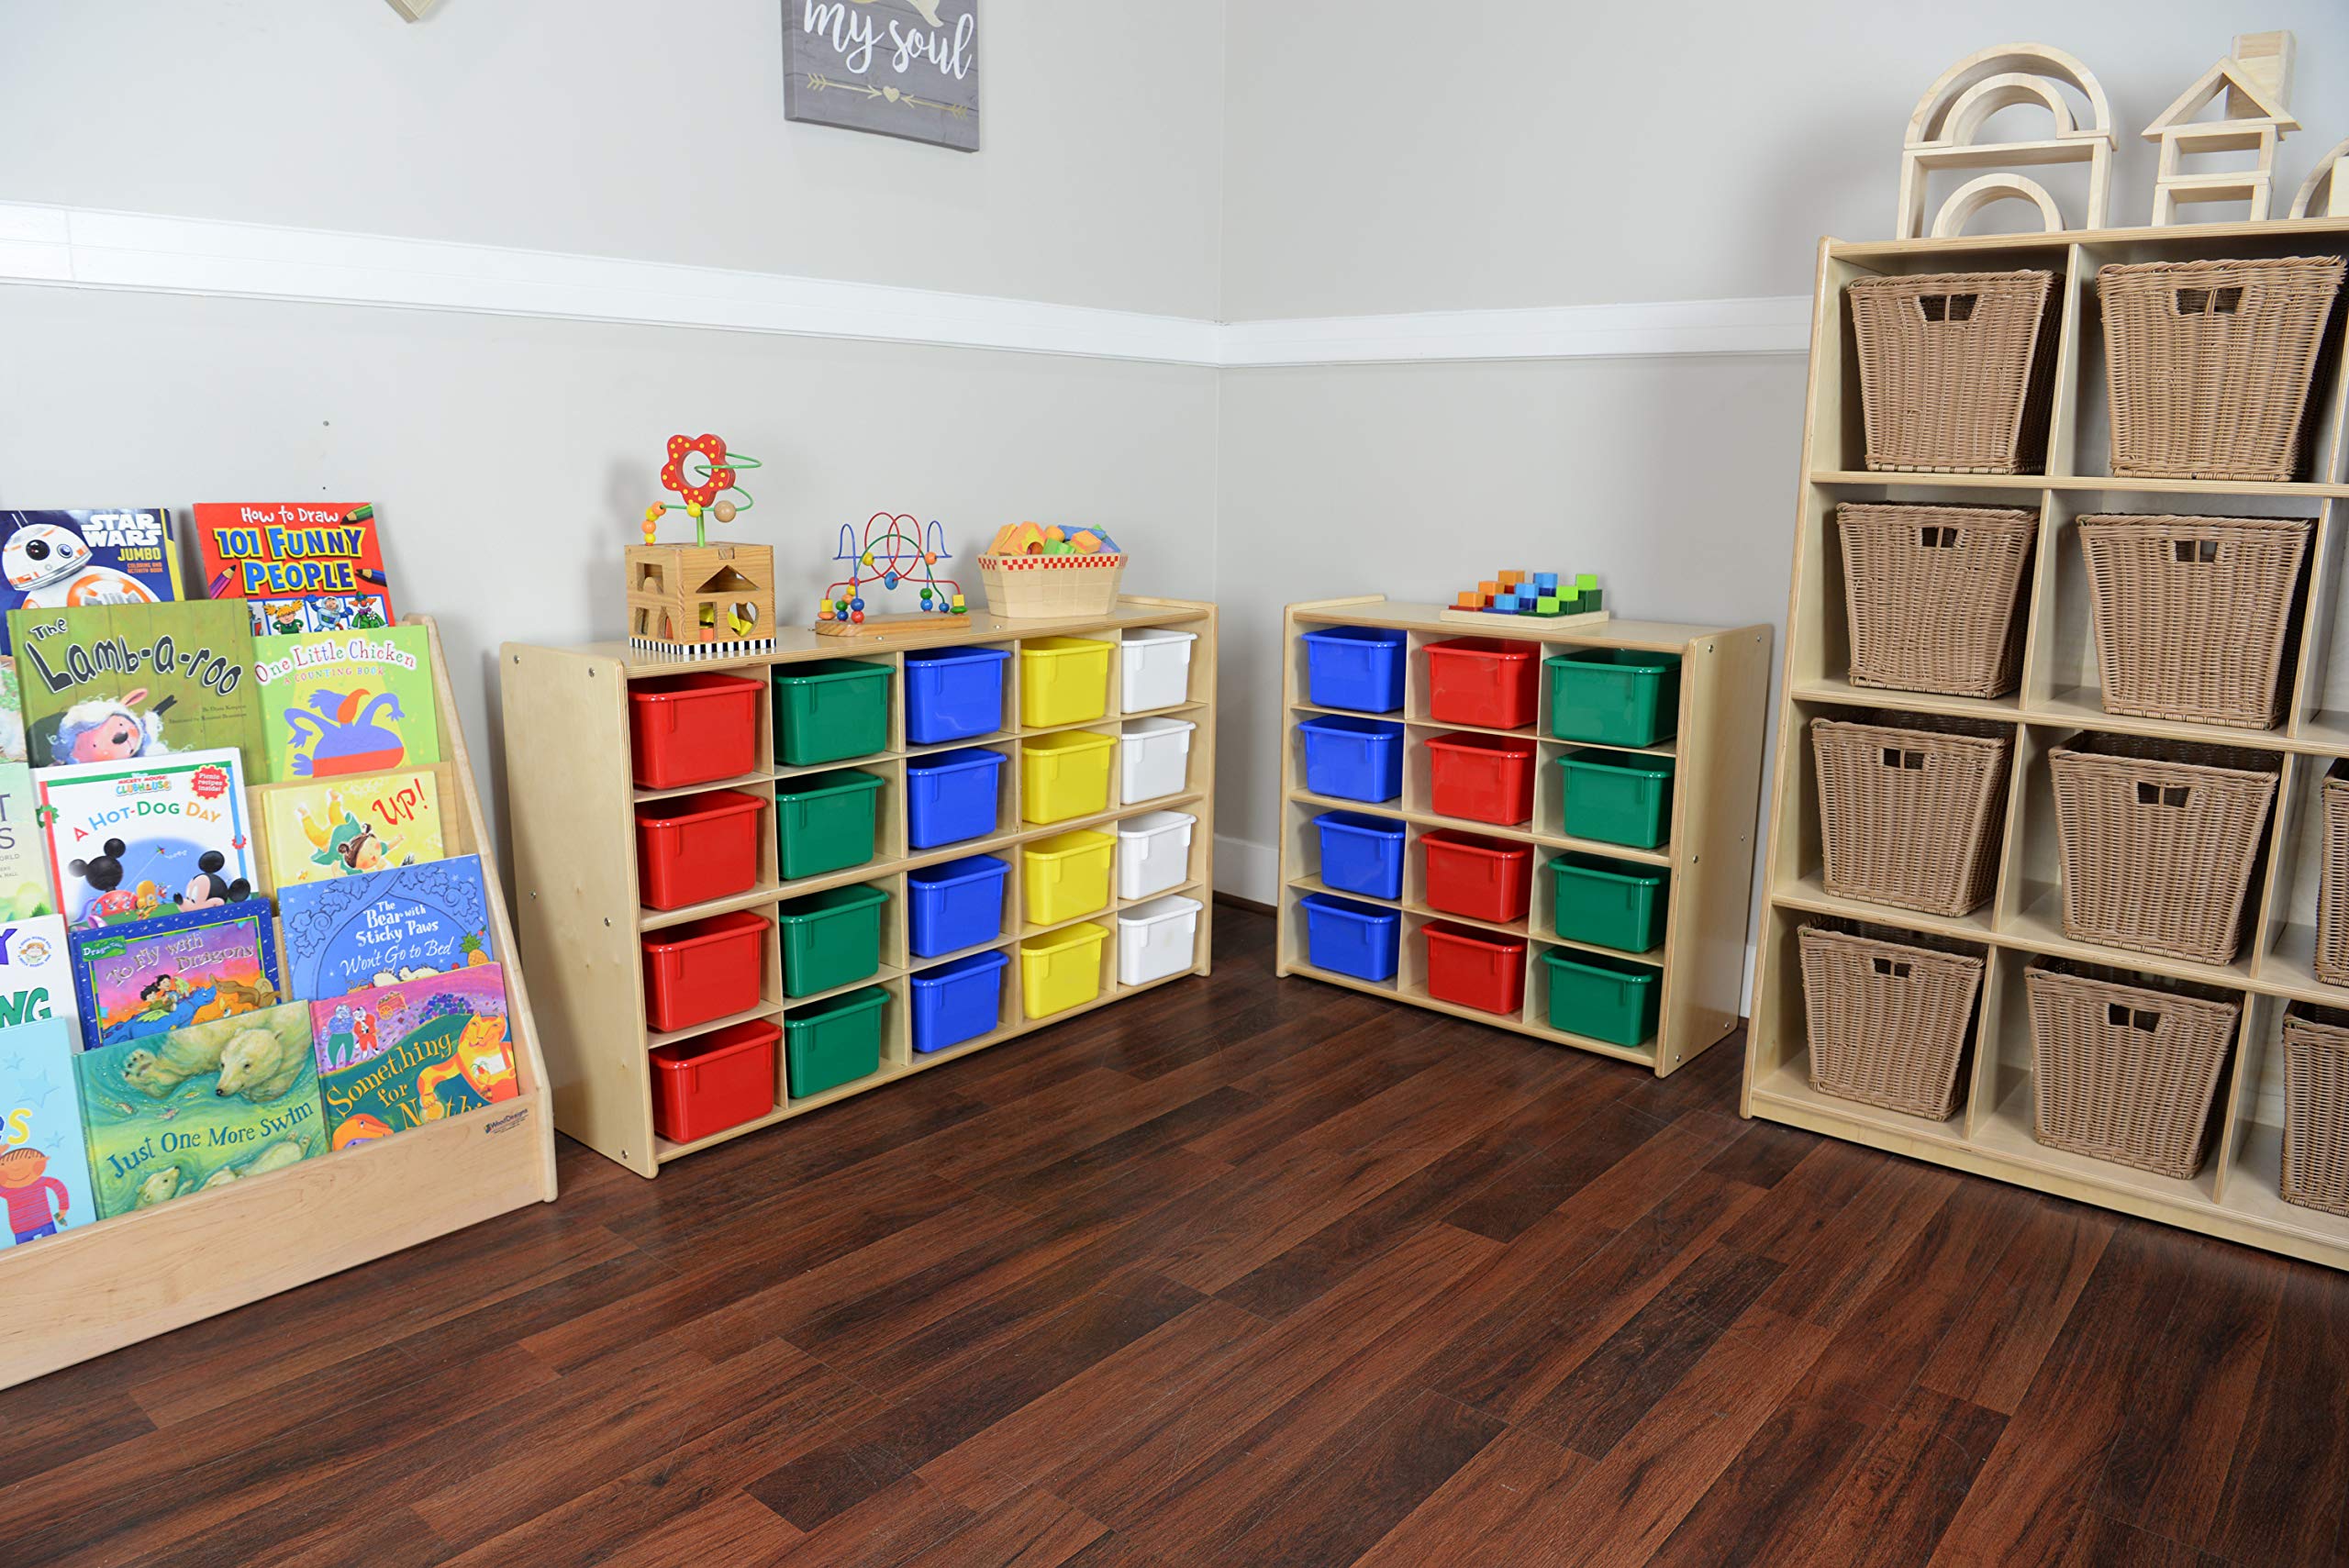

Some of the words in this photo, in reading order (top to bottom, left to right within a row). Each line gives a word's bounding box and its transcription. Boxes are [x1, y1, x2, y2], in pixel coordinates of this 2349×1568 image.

[804, 0, 885, 74] my
[889, 13, 974, 80] soul
[81, 513, 161, 531] STAR
[240, 506, 275, 524] How
[278, 505, 295, 524] to
[297, 507, 340, 524] Draw
[82, 529, 162, 548] WARS
[213, 528, 264, 559] 101
[264, 524, 366, 561] FUNNY
[117, 547, 161, 562] JUMBO
[240, 559, 357, 595] PEOPLE
[30, 617, 68, 640] The
[254, 660, 291, 683] One
[293, 641, 344, 667] Little
[350, 640, 416, 668] Chicken
[284, 677, 291, 685] A
[295, 667, 352, 683] COUNTING
[357, 667, 385, 676] BOOK
[73, 827, 89, 842] A
[185, 801, 221, 823] DAY
[363, 909, 404, 929] Bear
[405, 905, 427, 917] with
[376, 900, 395, 913] The
[355, 925, 403, 947] Sticky
[406, 919, 440, 936] Paws
[106, 965, 135, 987] To
[133, 946, 161, 973] Fly
[165, 932, 205, 956] with
[175, 945, 254, 974] Dragons
[340, 949, 383, 976] Won't
[384, 945, 406, 971] Go
[409, 944, 421, 959] to
[424, 936, 455, 956] Bed
[326, 1033, 452, 1118] Something
[377, 1083, 409, 1108] for
[106, 1137, 156, 1179] Just
[161, 1132, 201, 1153] One
[208, 1126, 256, 1147] More
[260, 1101, 314, 1138] Swim
